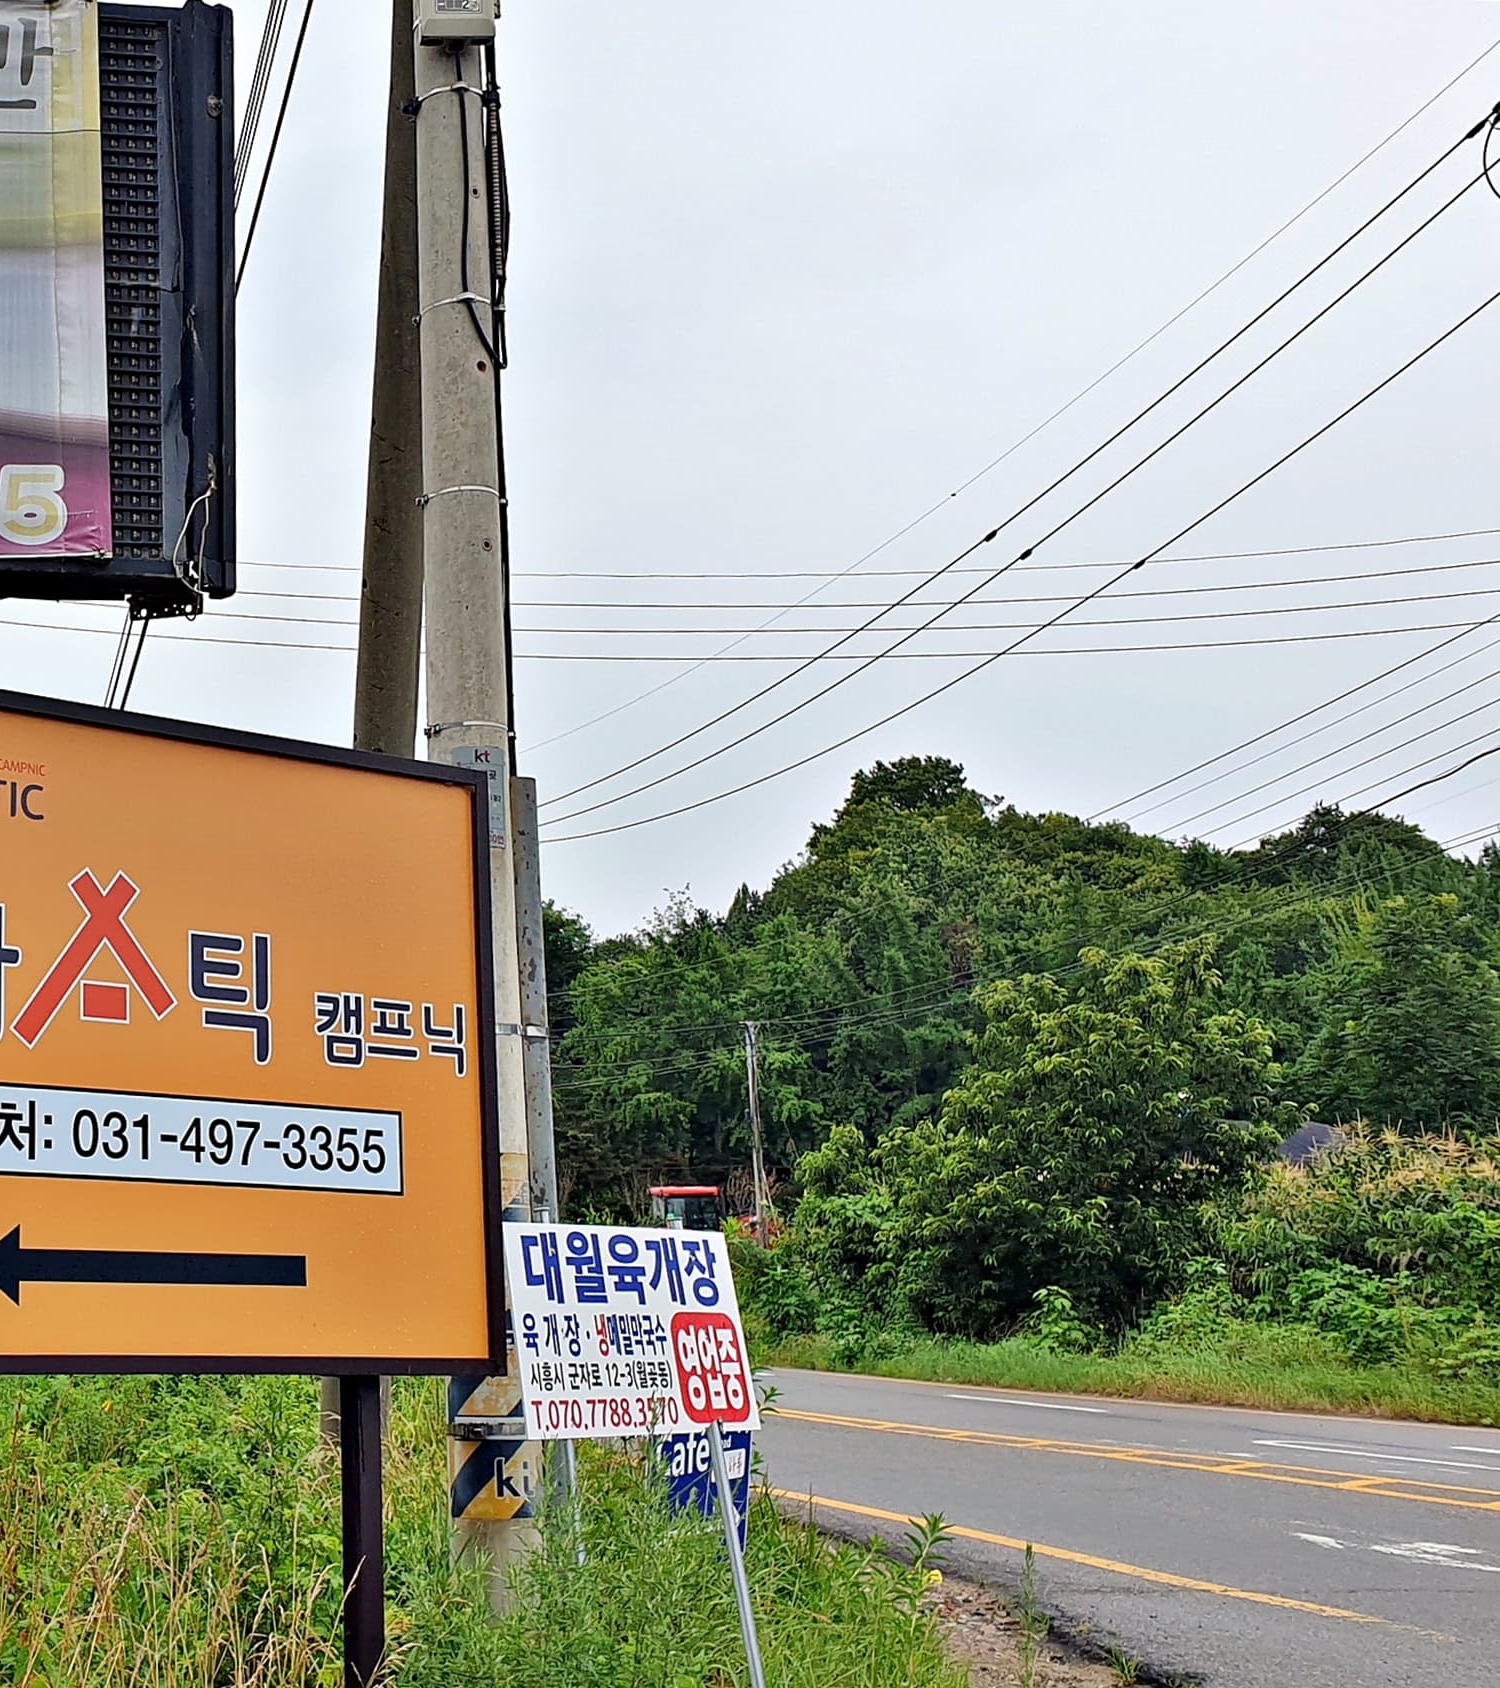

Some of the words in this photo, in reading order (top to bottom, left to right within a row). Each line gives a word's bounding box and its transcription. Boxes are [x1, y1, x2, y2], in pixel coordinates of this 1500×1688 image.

[474, 749, 491, 764] kt
[313, 990, 469, 1078] 캠프닉
[71, 1108, 387, 1175] 031-497-3355
[520, 1230, 720, 1307] 대월육개장
[531, 1361, 566, 1391] 시흥시
[568, 1361, 603, 1390] 군자로
[677, 1324, 744, 1411] 영업중
